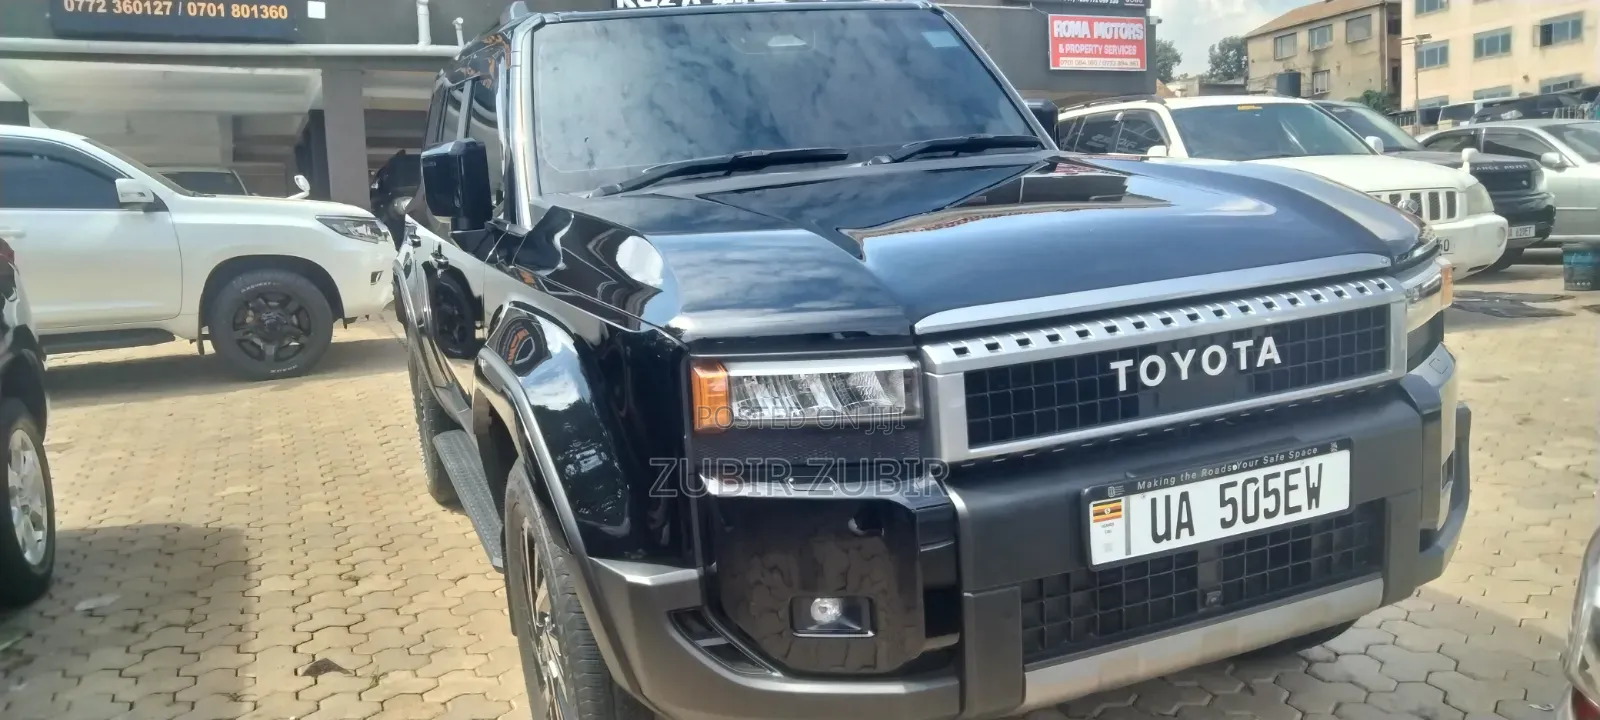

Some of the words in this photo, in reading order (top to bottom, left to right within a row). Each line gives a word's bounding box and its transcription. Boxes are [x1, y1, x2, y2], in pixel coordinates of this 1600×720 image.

[112, 0, 173, 15] 360127
[187, 3, 225, 17] 0701
[231, 4, 288, 19] 801360
[1053, 20, 1091, 39] ROMA
[1093, 21, 1144, 40] MOTORS
[1065, 44, 1103, 55] PROPERTY
[1103, 45, 1137, 55] SERVICES
[1109, 336, 1282, 392] TOYOTA
[1137, 475, 1176, 491] Making
[1180, 470, 1197, 482] the
[1201, 464, 1233, 478] Roads
[1236, 458, 1259, 470] Your
[1263, 453, 1285, 465] Safe
[1288, 446, 1318, 460] Space
[1150, 490, 1195, 544] UA
[1219, 463, 1323, 530] 505EW
